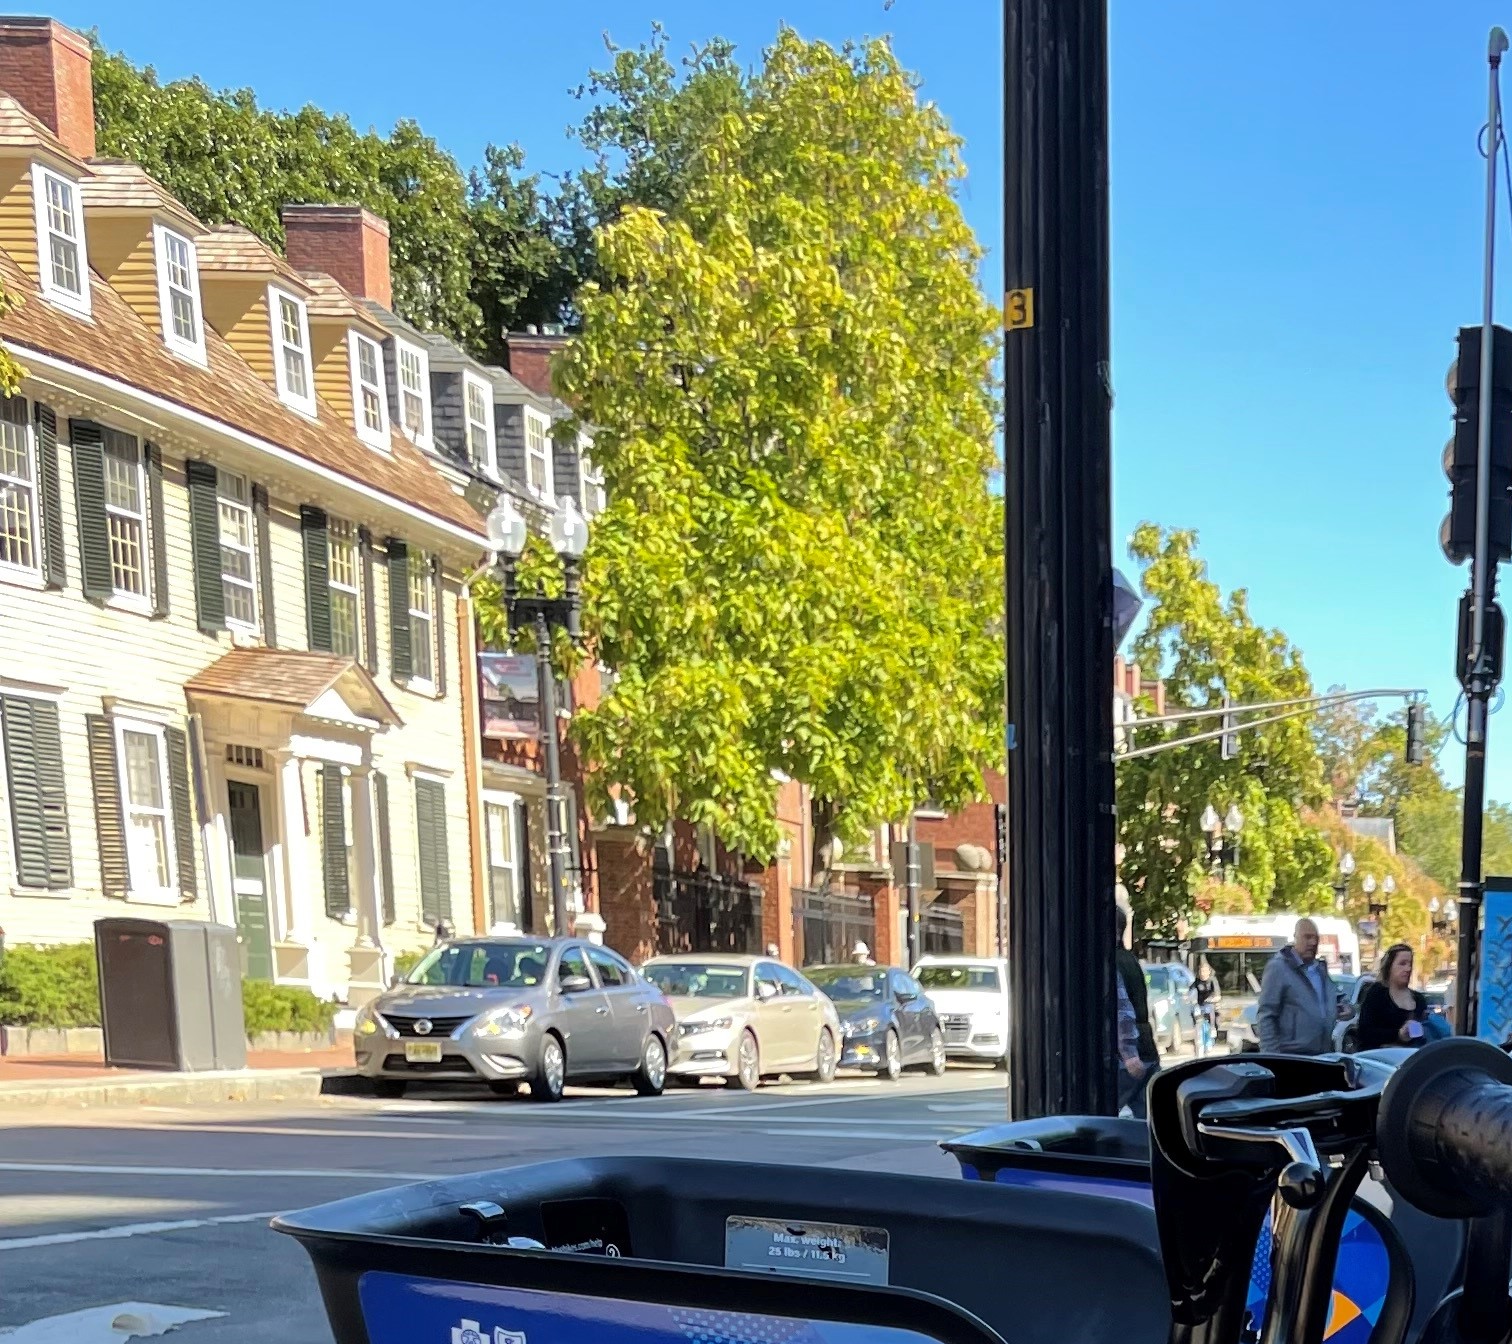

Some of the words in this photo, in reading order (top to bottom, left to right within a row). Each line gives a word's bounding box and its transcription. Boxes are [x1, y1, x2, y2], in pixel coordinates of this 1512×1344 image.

[1009, 291, 1027, 326] 3
[772, 1232, 798, 1246] Max.
[768, 1246, 782, 1257] 25
[783, 1247, 801, 1258] lbs
[831, 1250, 846, 1264] kg
